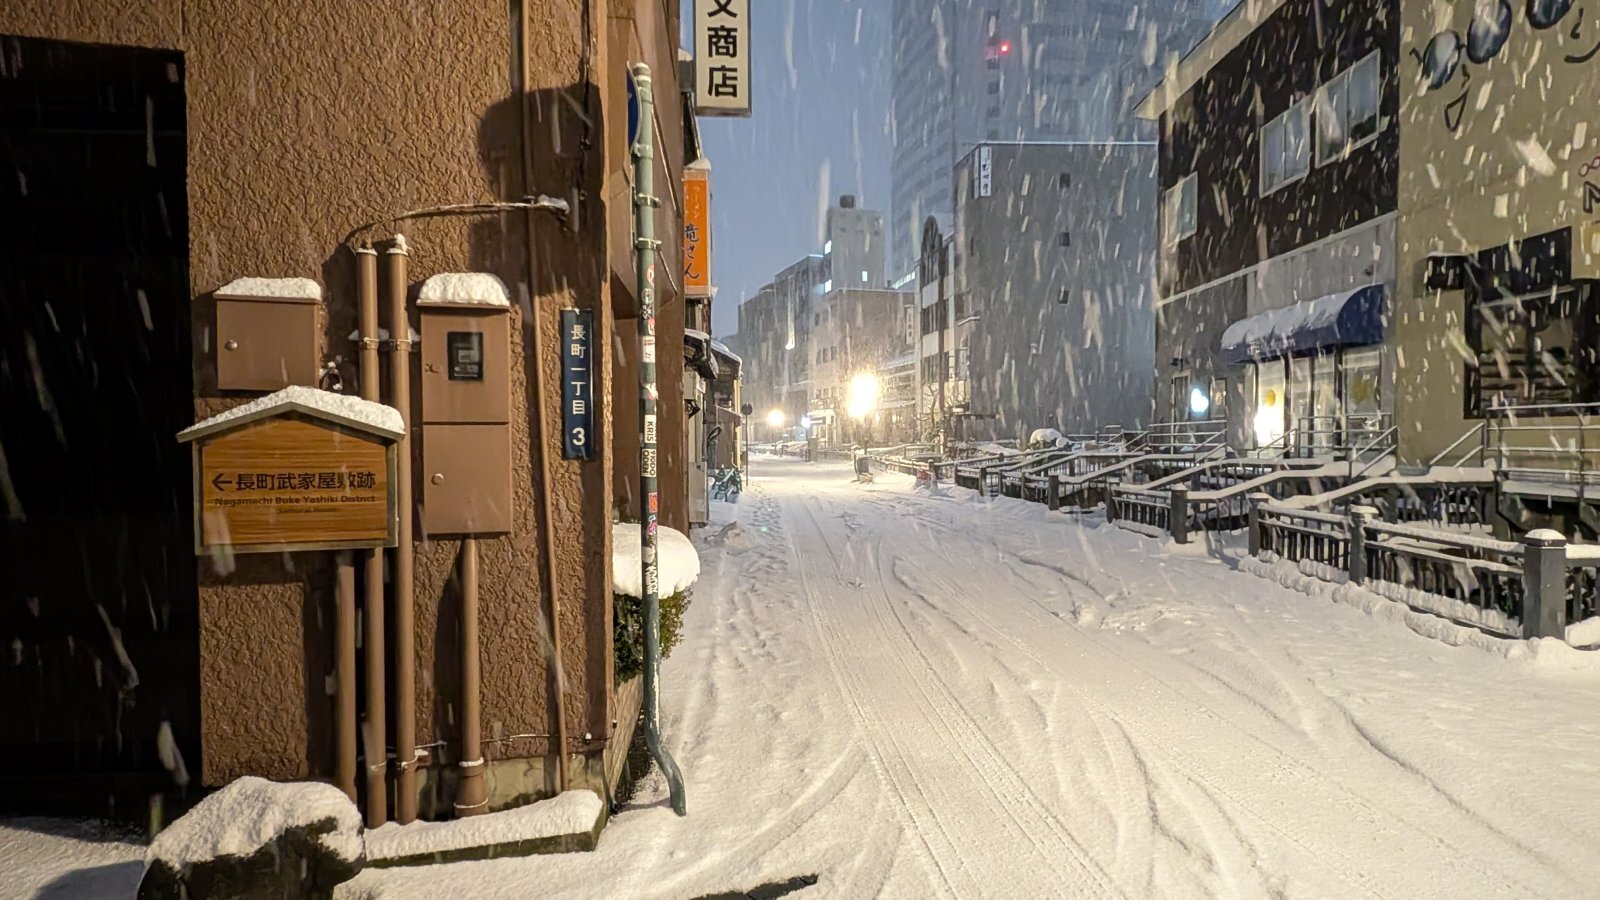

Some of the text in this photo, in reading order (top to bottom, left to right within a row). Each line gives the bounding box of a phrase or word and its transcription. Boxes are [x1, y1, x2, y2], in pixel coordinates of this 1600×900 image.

[572, 427, 586, 446] 3
[235, 471, 376, 491] 長町武家屋敷跡
[214, 495, 376, 507] Nagamachi Buke Yashiki District
